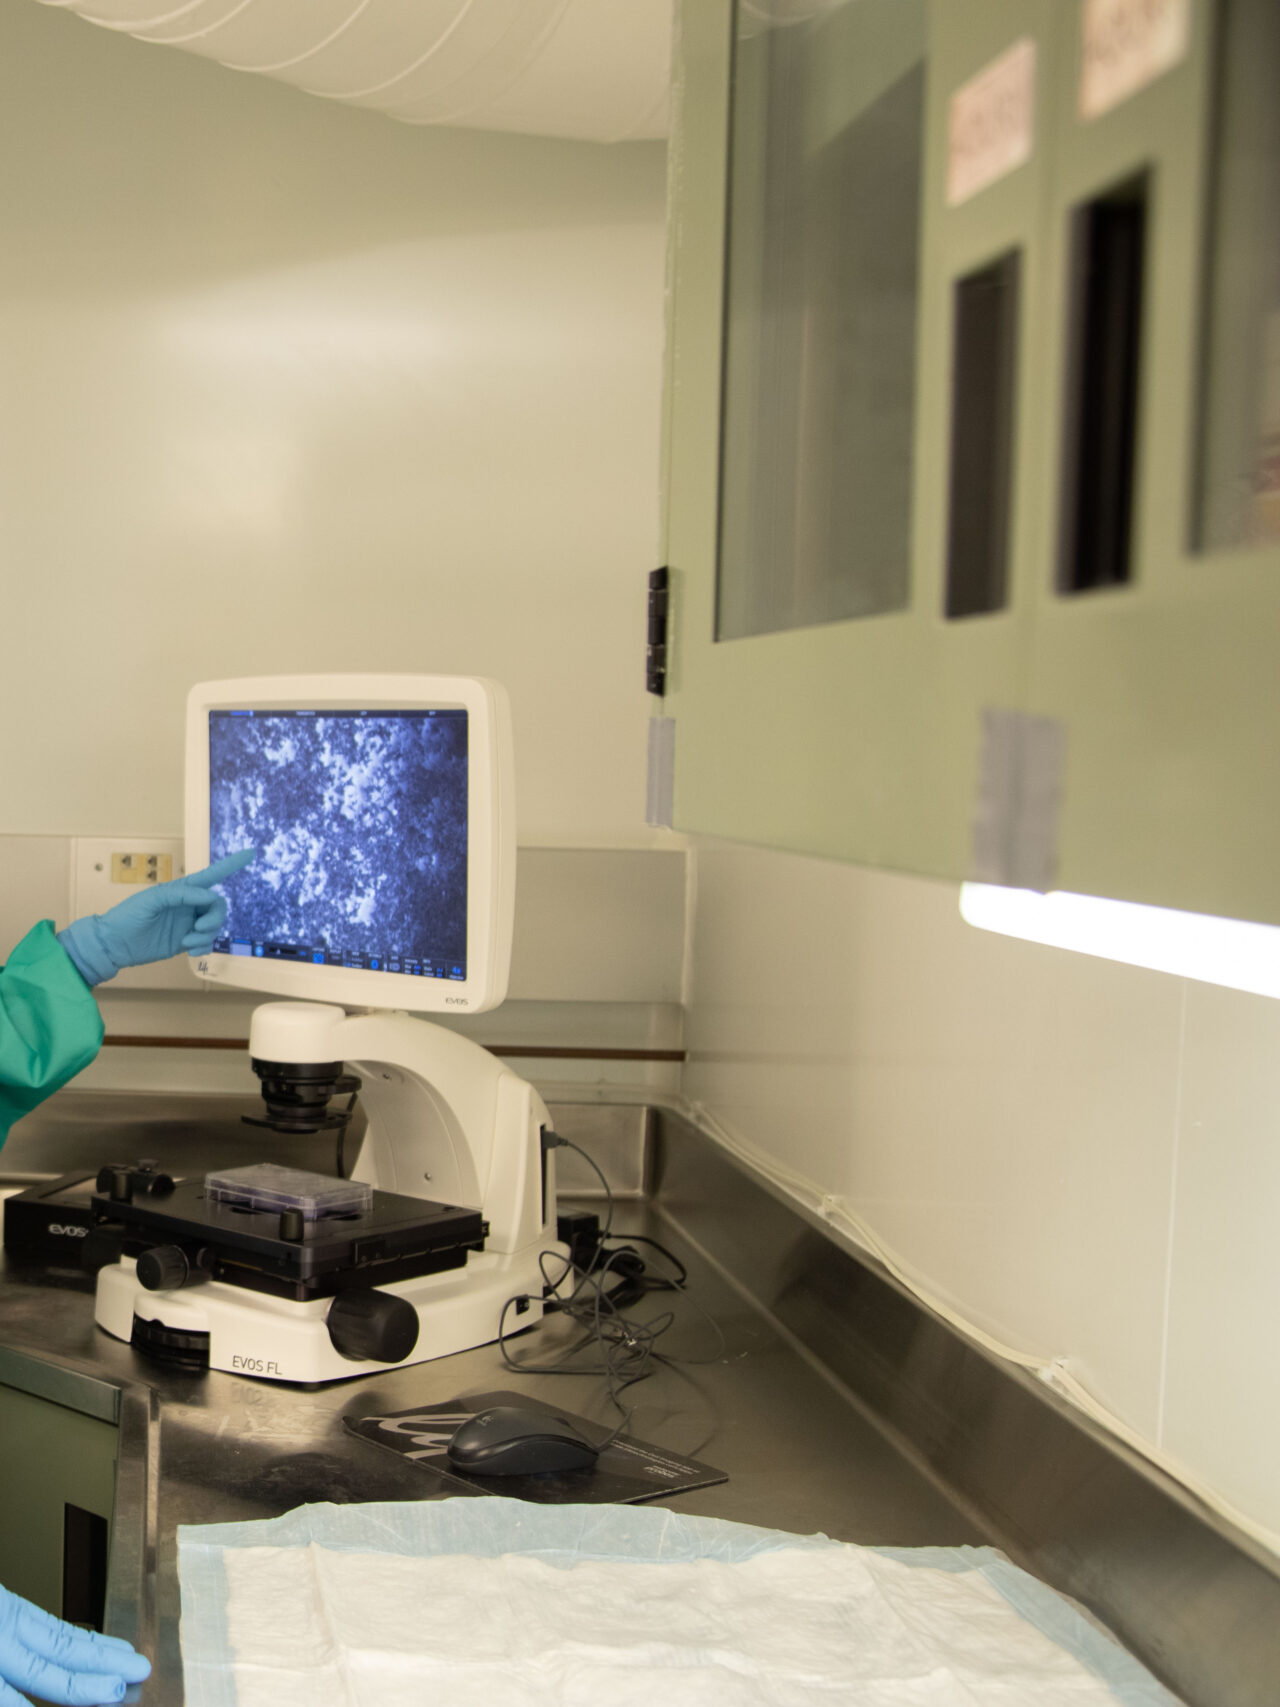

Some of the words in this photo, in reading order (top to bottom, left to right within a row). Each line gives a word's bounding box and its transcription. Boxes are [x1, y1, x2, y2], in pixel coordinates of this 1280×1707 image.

[49, 1224, 86, 1238] EVOS
[232, 1355, 264, 1372] EVOS
[267, 1361, 283, 1376] FL
